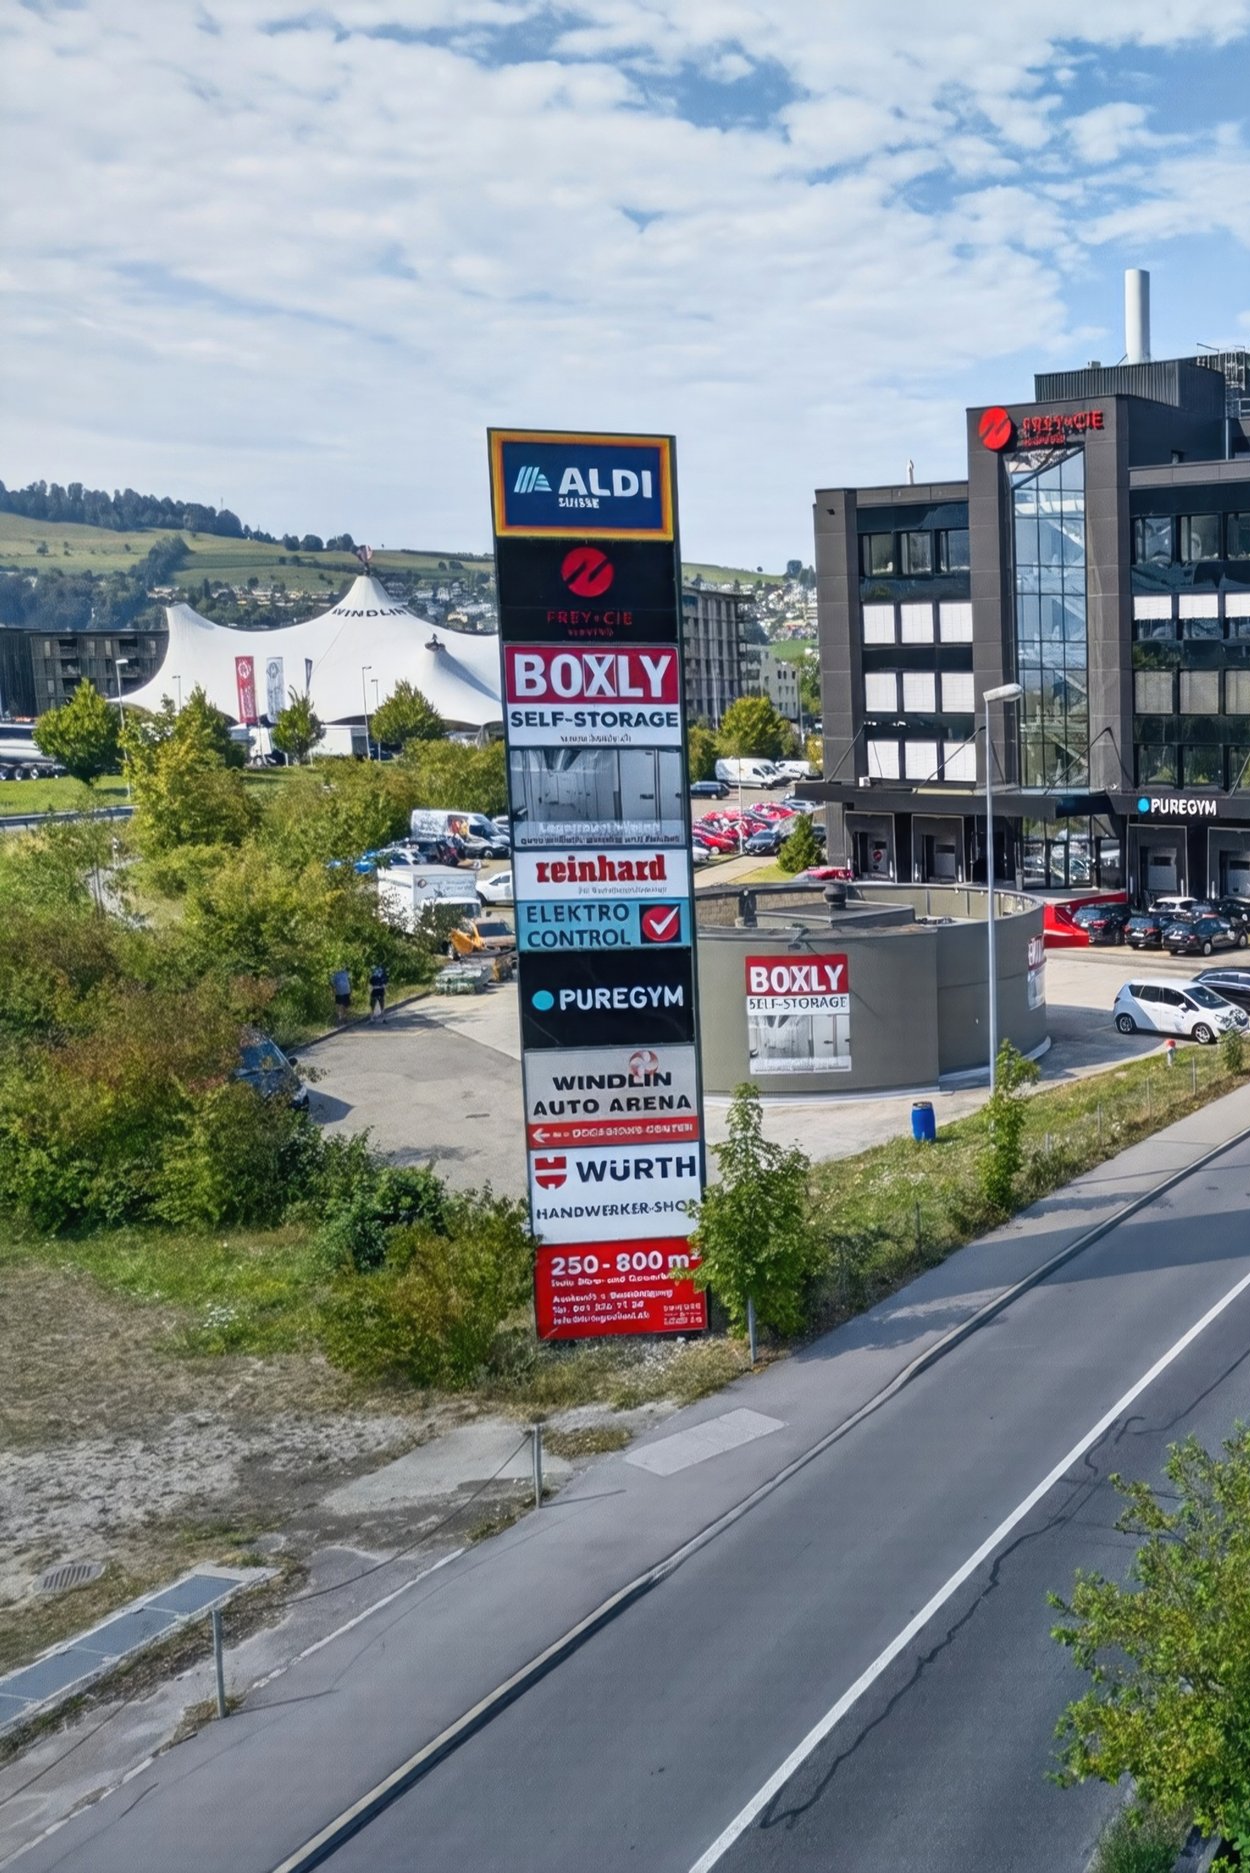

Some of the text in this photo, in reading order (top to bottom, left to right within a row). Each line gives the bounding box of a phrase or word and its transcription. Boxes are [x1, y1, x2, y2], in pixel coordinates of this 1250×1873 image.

[558, 466, 652, 499] ALDI
[513, 653, 672, 698] BOXLY
[511, 710, 679, 728] SELF-STORAGE
[1150, 798, 1217, 816] PUREGYM
[536, 854, 667, 883] reinhard
[526, 903, 630, 923] ELEKTRO
[527, 929, 631, 948] CONTROL
[750, 964, 844, 993] BOXLY
[559, 985, 684, 1011] PUREGYM
[749, 996, 848, 1010] SELF-STORAGE
[552, 1072, 672, 1091] WINDLIN
[533, 1094, 692, 1116] AUTO ARENA
[576, 1155, 696, 1183] WÜRTH
[536, 1199, 695, 1220] HANDWERKER-SHO
[551, 1255, 599, 1276] 250
[616, 1250, 663, 1272] 800
